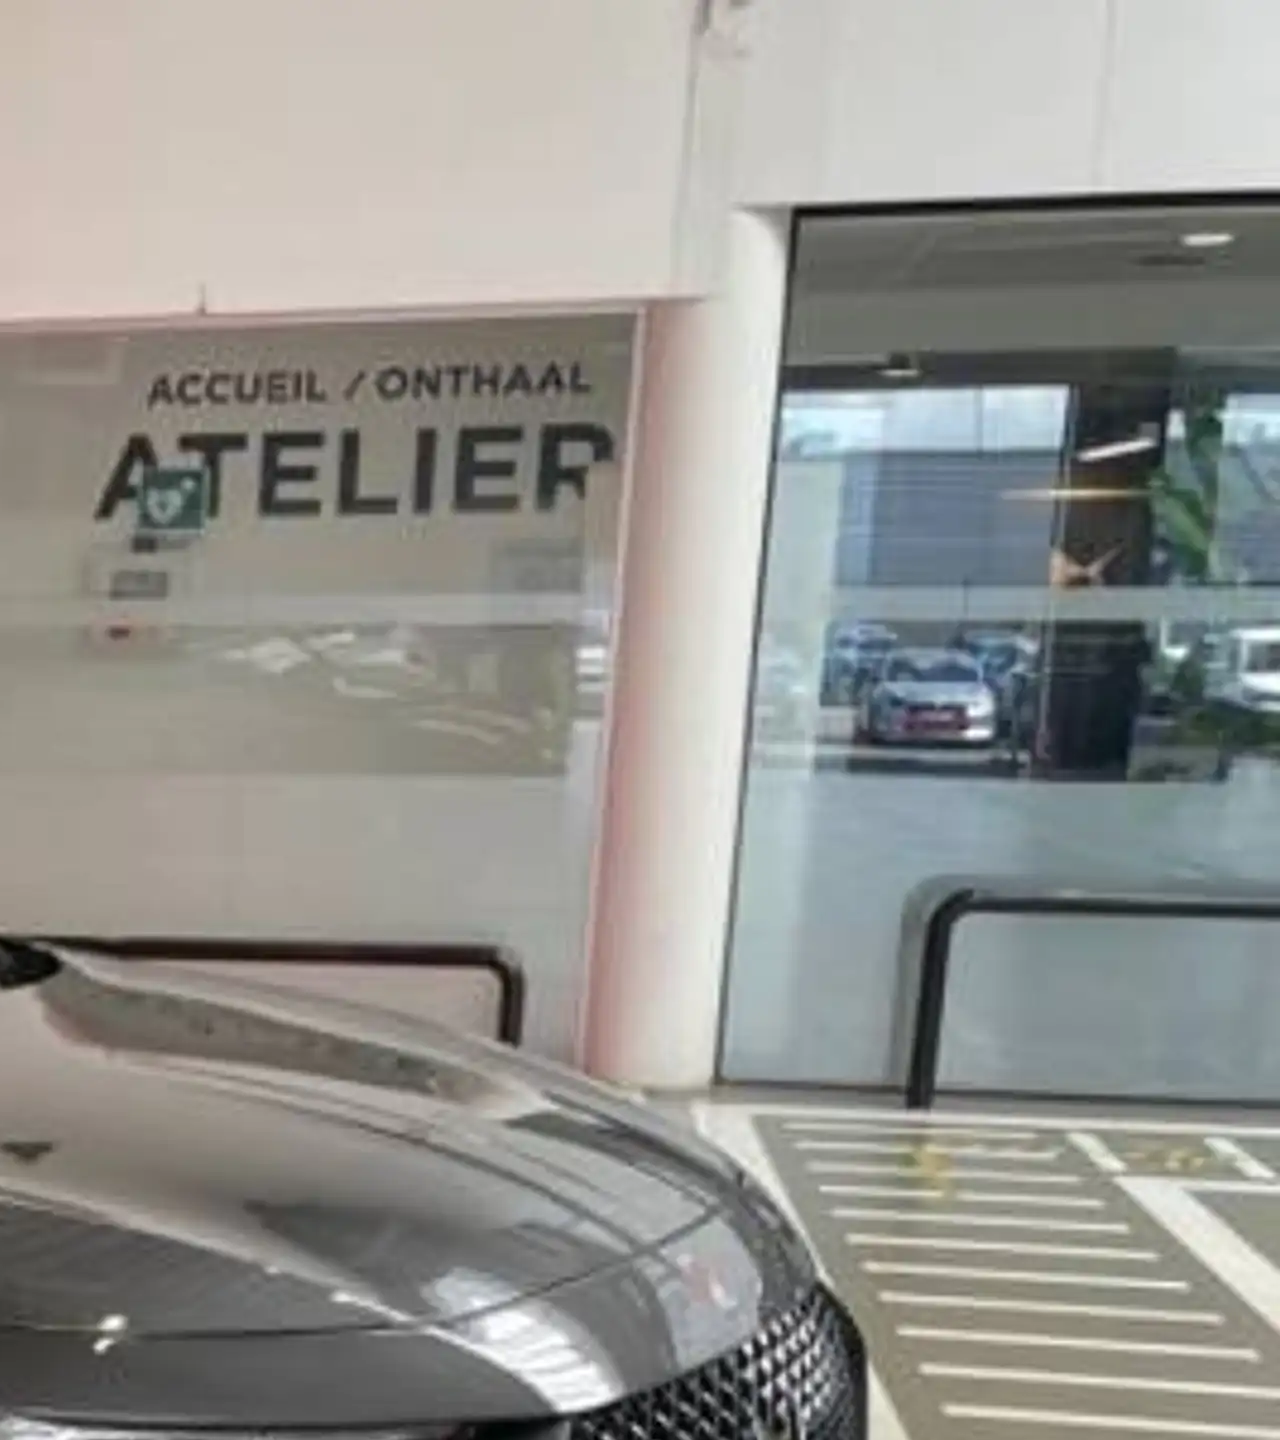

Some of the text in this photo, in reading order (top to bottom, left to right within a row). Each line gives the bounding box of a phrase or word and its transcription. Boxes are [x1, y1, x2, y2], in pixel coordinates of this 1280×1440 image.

[147, 369, 327, 409] ACCUEIL
[374, 359, 593, 398] ONTHAAL
[93, 422, 618, 521] ATELIER
